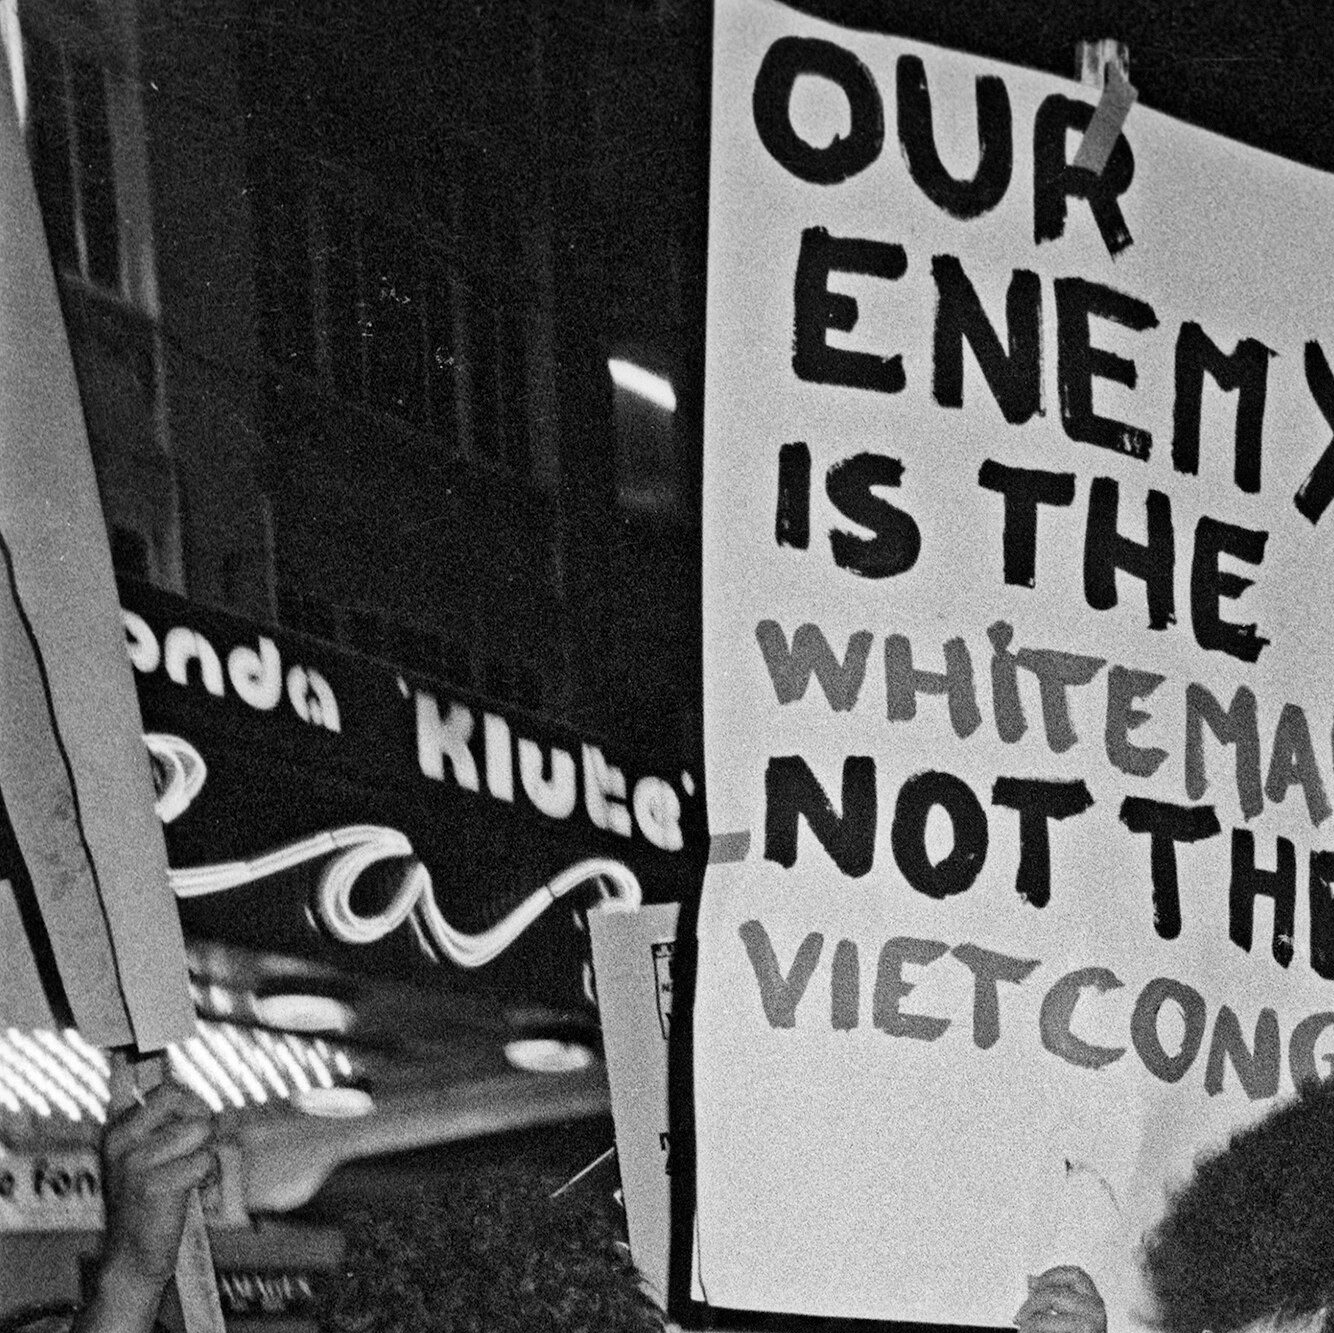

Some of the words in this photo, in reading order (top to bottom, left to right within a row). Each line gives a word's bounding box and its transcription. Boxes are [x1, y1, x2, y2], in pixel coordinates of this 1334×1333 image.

[753, 36, 1135, 261] OUR
[774, 442, 921, 580] IS
[978, 459, 1270, 663] THE
[763, 755, 1095, 909] NOT
